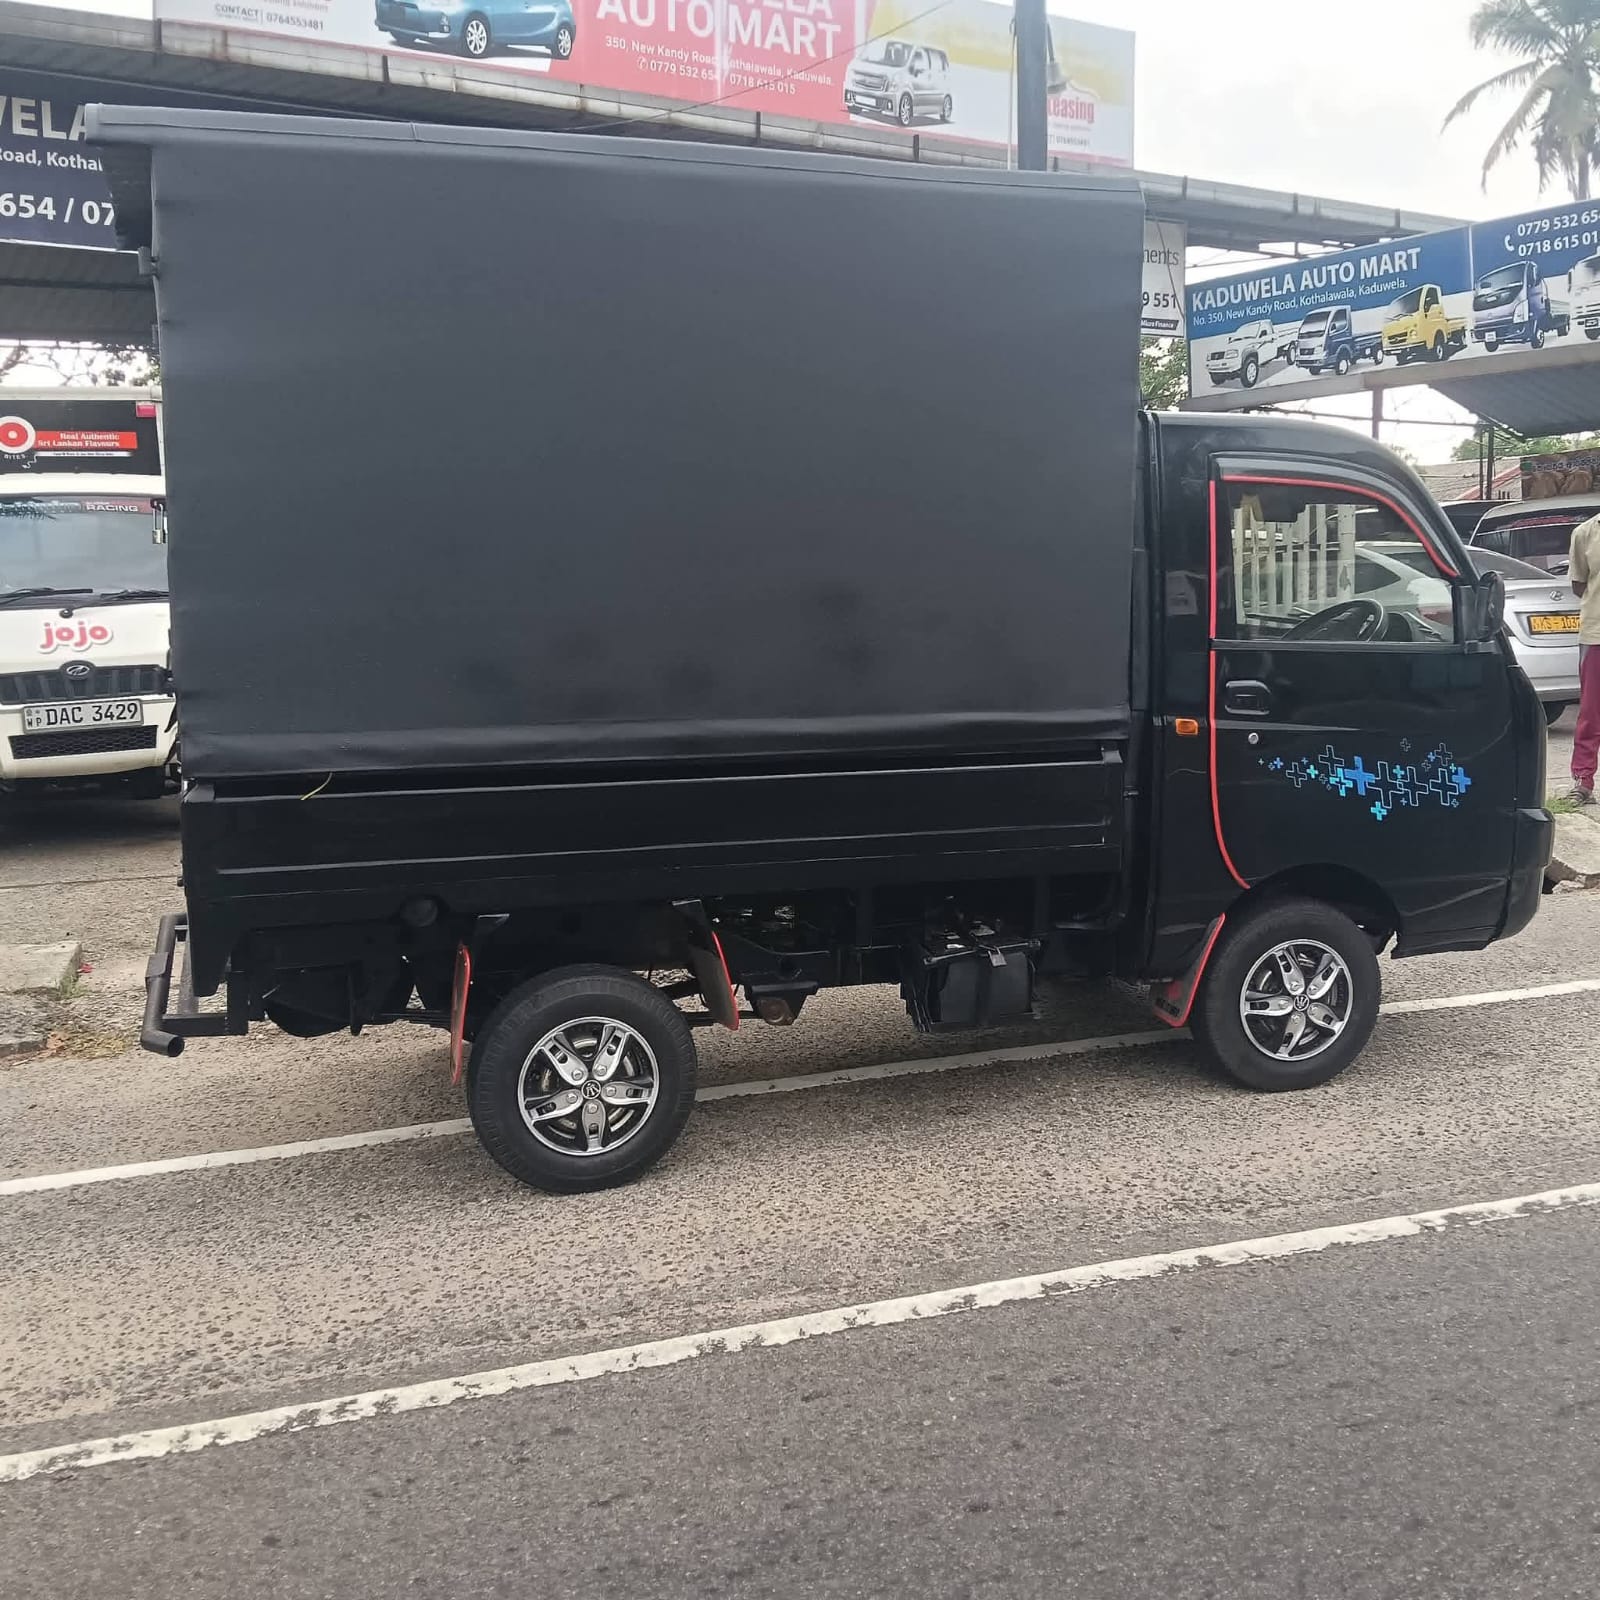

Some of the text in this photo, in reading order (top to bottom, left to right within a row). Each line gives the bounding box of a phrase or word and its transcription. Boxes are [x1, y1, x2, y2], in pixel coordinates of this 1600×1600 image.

[215, 3, 259, 17] CONTACT
[595, 0, 715, 38] AUTO
[728, 4, 841, 58] MART
[605, 35, 629, 54] 350,
[631, 40, 656, 56] New
[657, 44, 690, 63] Kandy
[650, 60, 677, 75] 0779
[679, 64, 700, 79] 532
[730, 73, 755, 88] 0718
[777, 81, 796, 95] 015
[0, 148, 42, 166] oad,
[0, 193, 115, 226] 654 / 07
[1517, 219, 1550, 237] 0779
[1553, 214, 1579, 231] 532
[1518, 240, 1552, 257] 0718
[1553, 234, 1579, 251] 615
[1192, 247, 1421, 312] KADUWELA AUTO MART
[1152, 292, 1178, 309] 551
[1193, 277, 1409, 327] No. 350, New Kandy Road, Kothalawala, Kaduwela.
[38, 440, 120, 448] Sri Lankan Flavours
[60, 432, 120, 441] Real Authentic
[86, 503, 139, 512] RACING
[40, 620, 108, 649] jojo
[45, 706, 84, 726] DAC
[91, 702, 139, 722] 3429
